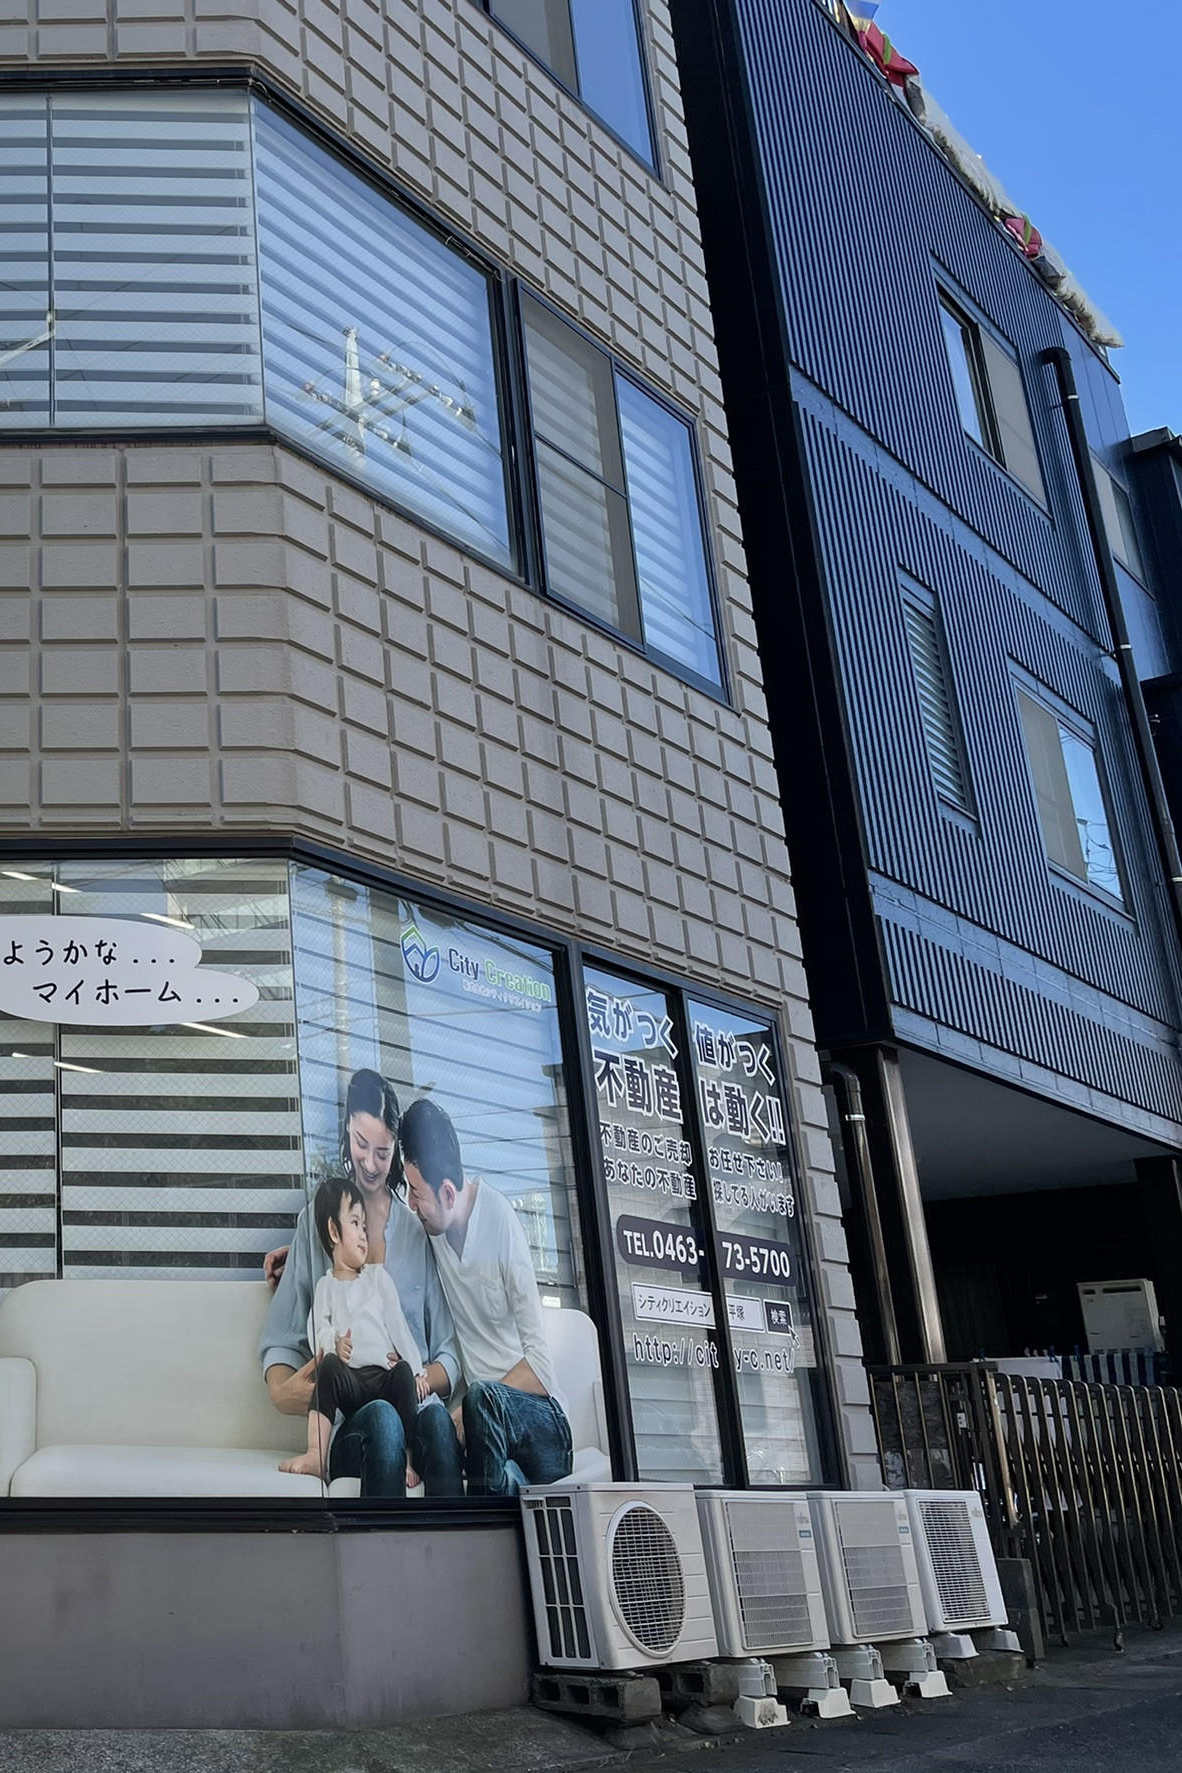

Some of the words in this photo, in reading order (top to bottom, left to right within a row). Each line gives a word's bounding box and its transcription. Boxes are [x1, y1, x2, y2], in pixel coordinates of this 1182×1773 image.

[448, 947, 479, 980] City
[484, 959, 552, 1002] Creation
[586, 988, 679, 1060] 気がつく
[694, 1021, 776, 1087] 値がつく
[592, 1046, 684, 1125] 不動産
[599, 1119, 693, 1167] 不動産のご売却
[603, 1157, 697, 1201] あなたの不動産
[712, 1178, 795, 1218] 探してる人がいます
[638, 1294, 712, 1318] シティクリエイション
[770, 1308, 789, 1326] 検索
